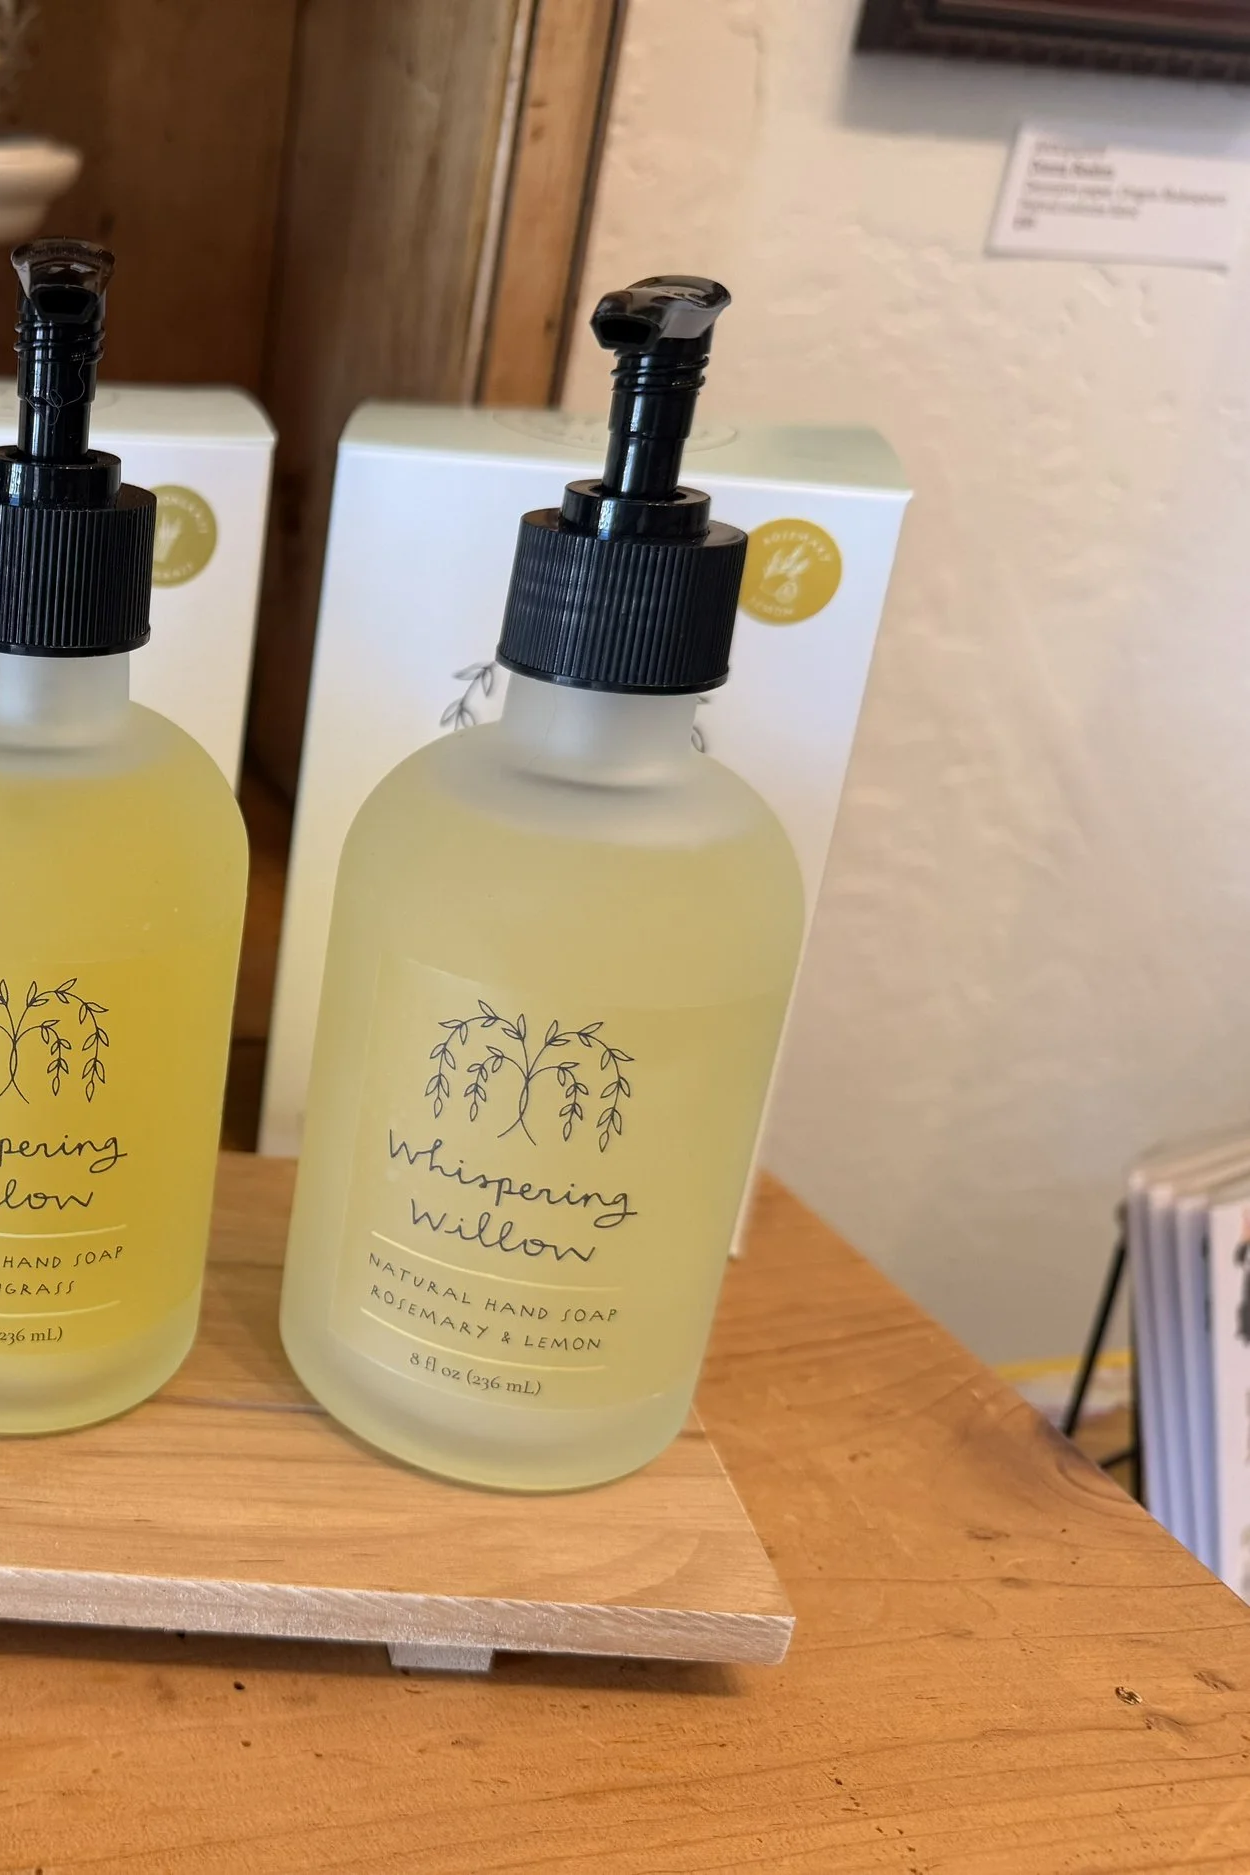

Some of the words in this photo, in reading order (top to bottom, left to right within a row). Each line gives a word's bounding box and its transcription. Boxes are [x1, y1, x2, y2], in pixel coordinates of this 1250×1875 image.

[389, 1128, 639, 1229] Whispering
[2, 1255, 62, 1269] HAND
[72, 1246, 124, 1268] SOAP
[410, 1198, 597, 1263] Willow
[368, 1251, 471, 1305] NATURAL
[484, 1297, 549, 1321] HAND
[560, 1308, 618, 1323] SOAP
[370, 1284, 490, 1340] ROSEMARY
[500, 1330, 511, 1345] &
[523, 1334, 602, 1352] LEMON
[30, 1325, 64, 1343] mL)
[409, 1352, 420, 1366] 8
[425, 1356, 437, 1373] fl
[441, 1366, 461, 1381] oz
[466, 1368, 503, 1390] (236
[505, 1381, 542, 1397] mL)
